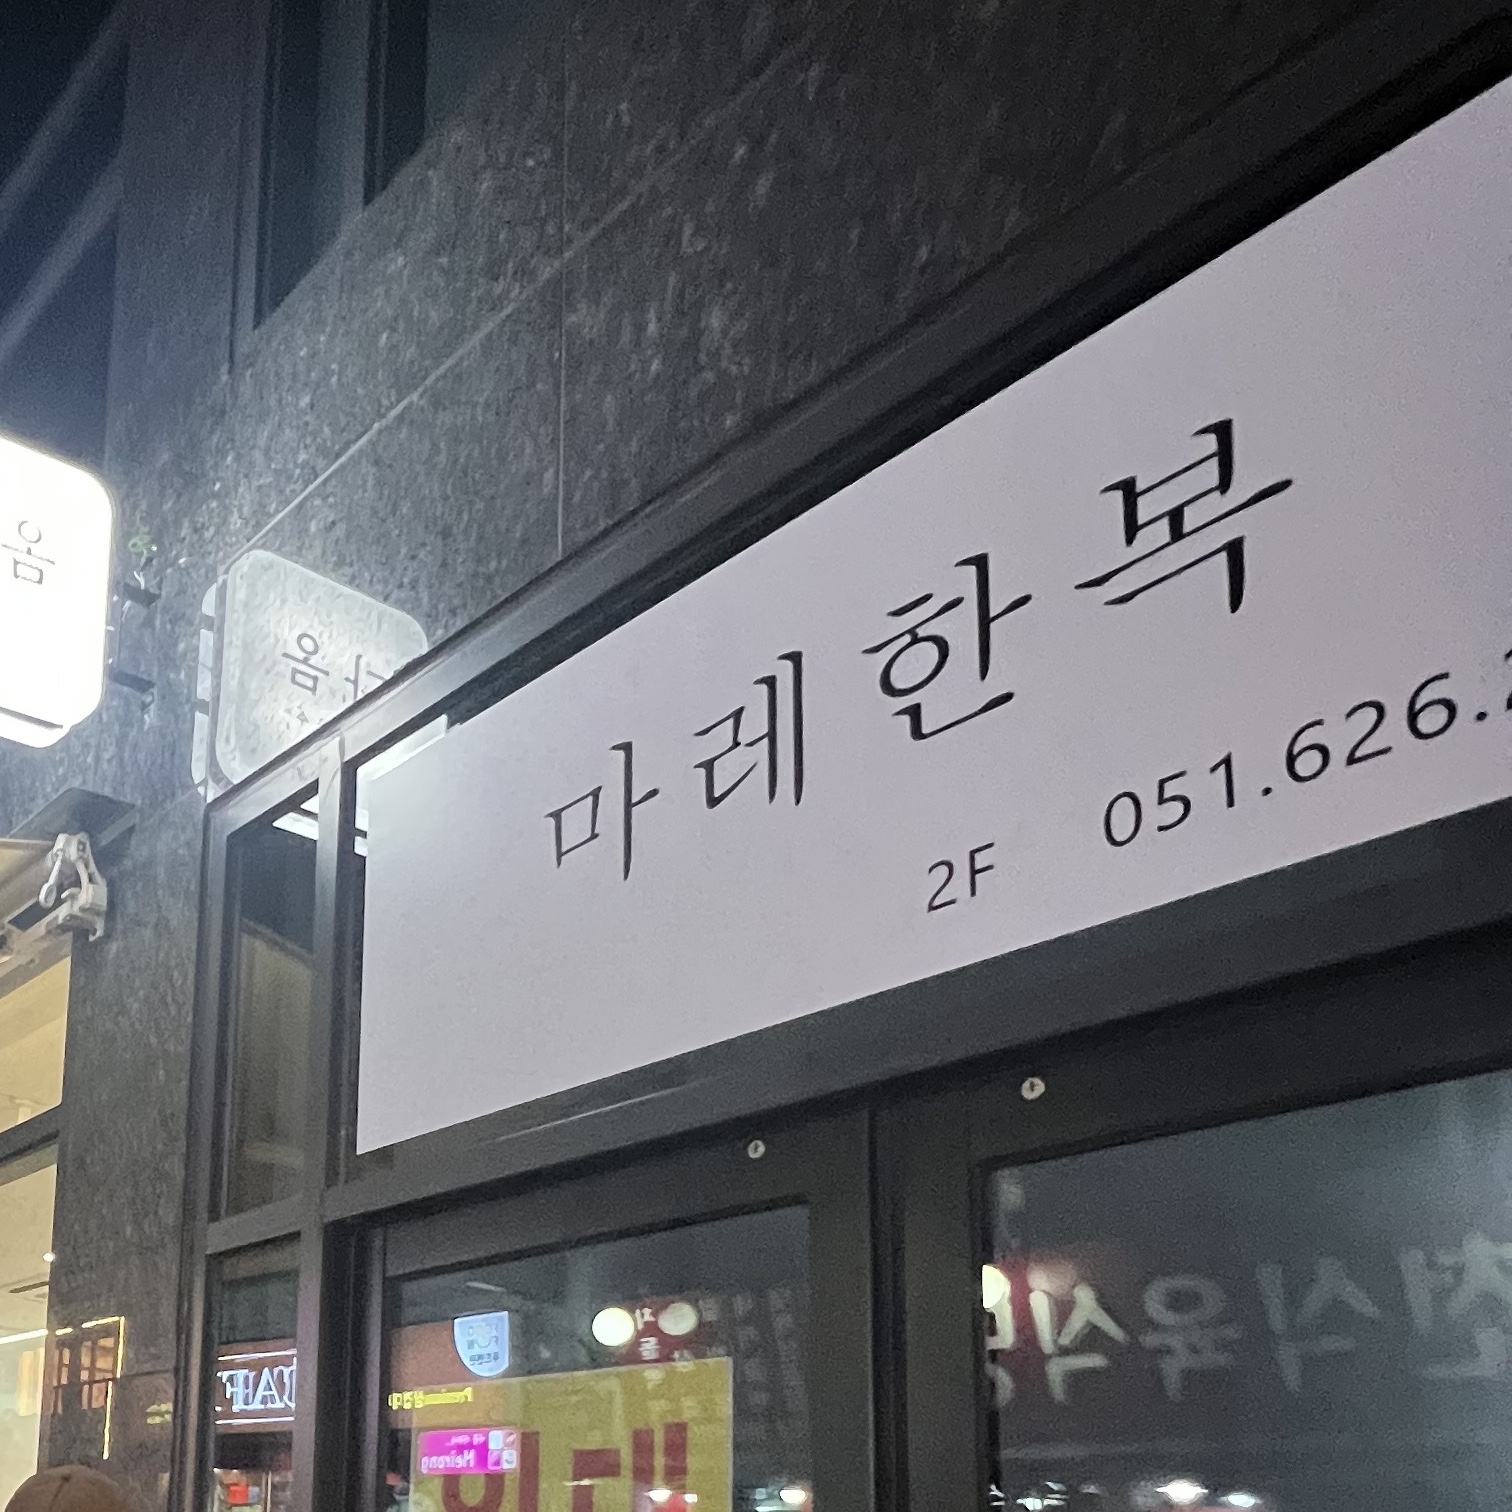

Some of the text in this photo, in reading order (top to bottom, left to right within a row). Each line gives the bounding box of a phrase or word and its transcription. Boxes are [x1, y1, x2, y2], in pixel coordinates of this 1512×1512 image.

[542, 418, 1293, 880] 마레한복
[926, 648, 1512, 914] 2F 051.626.
